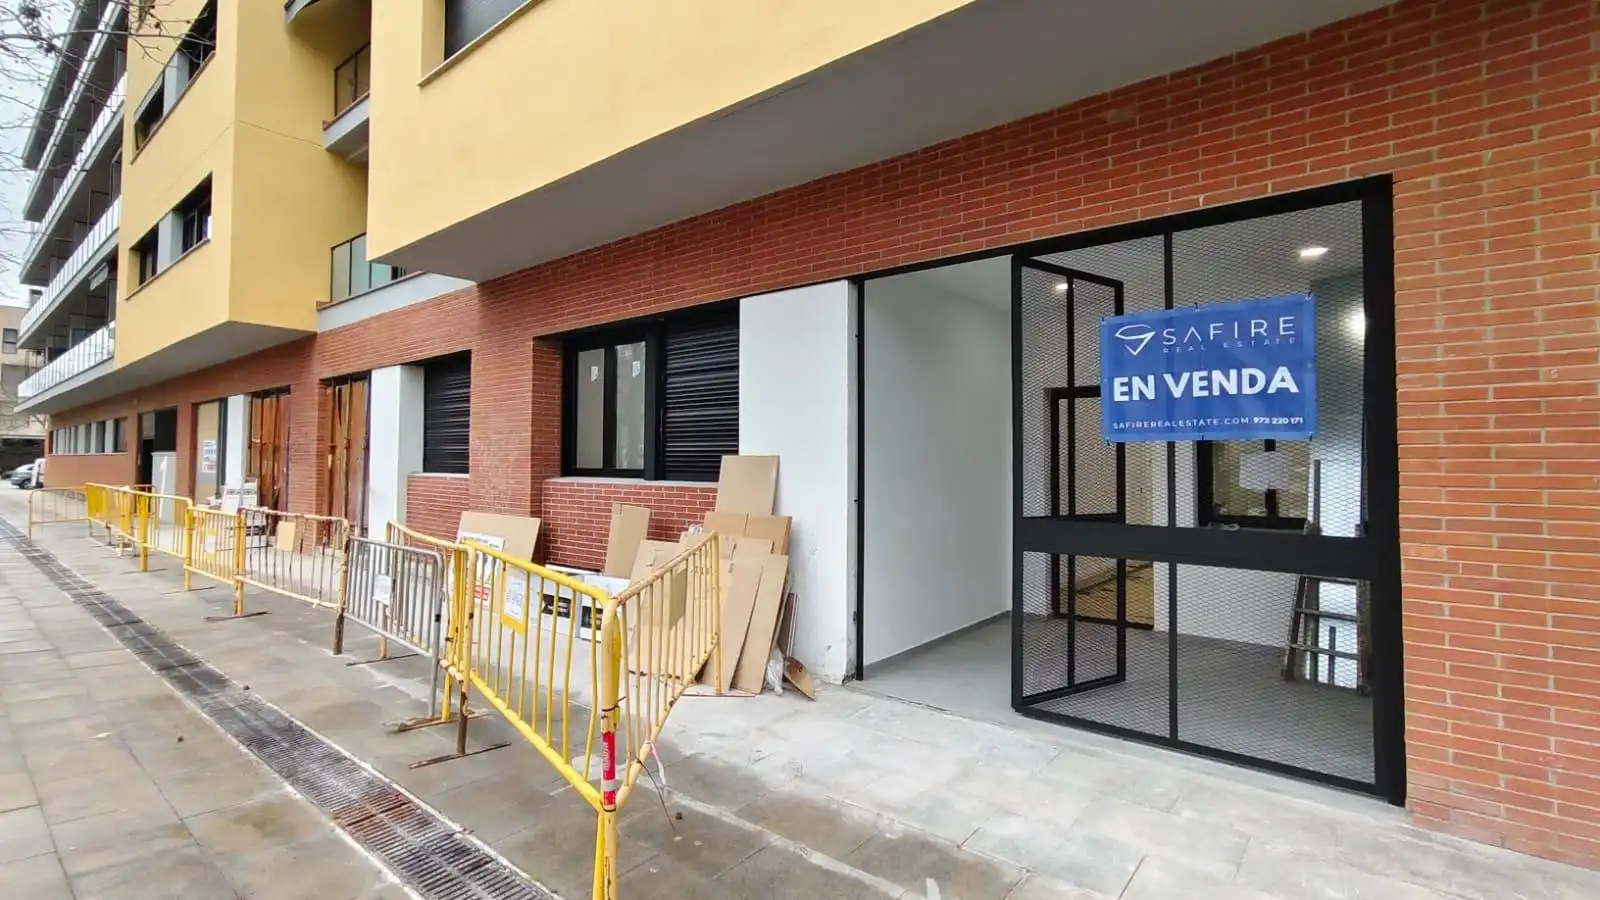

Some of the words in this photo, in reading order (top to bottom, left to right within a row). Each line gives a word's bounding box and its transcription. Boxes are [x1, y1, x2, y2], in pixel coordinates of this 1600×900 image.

[1162, 316, 1295, 345] SAFIRE
[1162, 345, 1206, 354] REAL
[1223, 337, 1295, 349] ESTATE
[1113, 374, 1156, 402] EN
[1163, 366, 1300, 399] VENDA
[1112, 416, 1249, 430] SAFIREREALESTATE.COM
[1271, 416, 1289, 425] 220
[1290, 416, 1304, 425] 171
